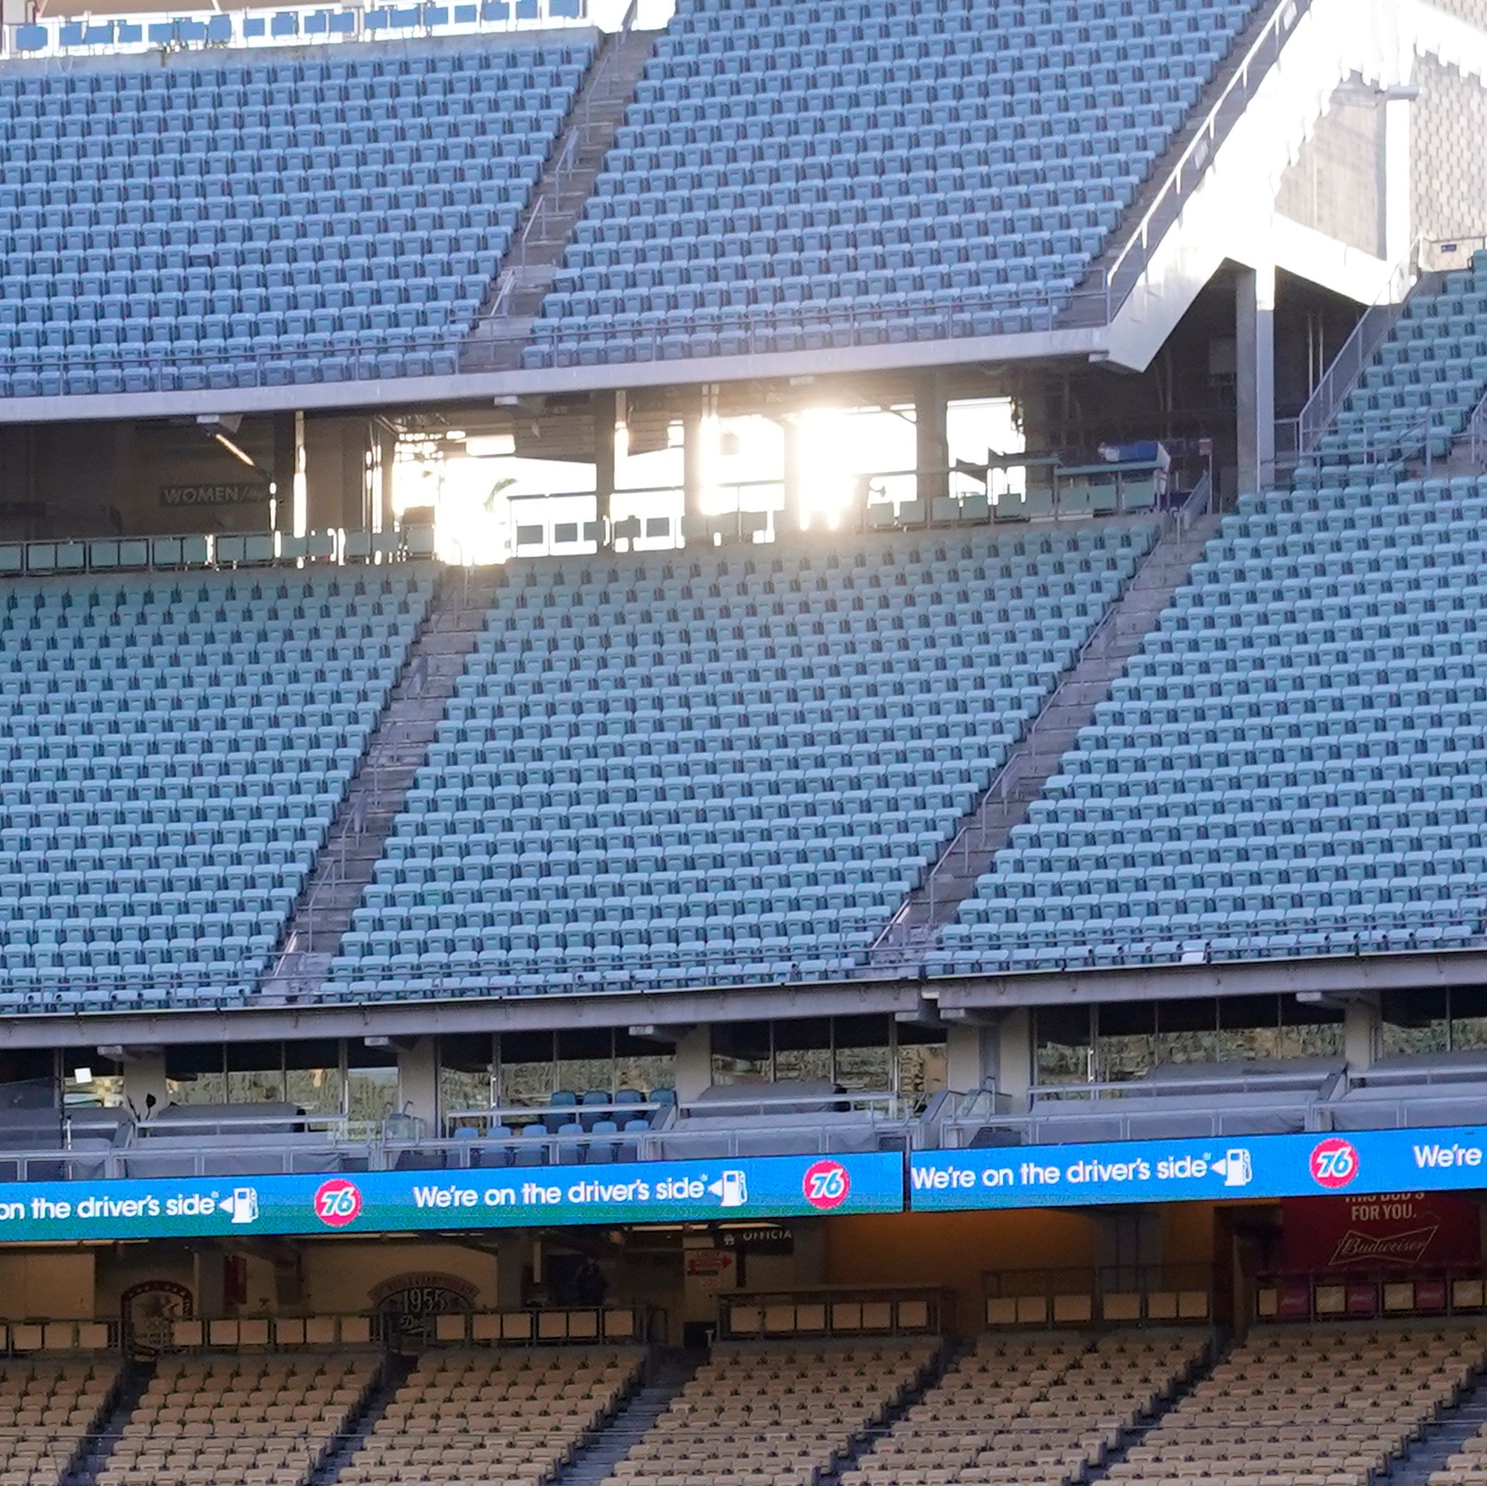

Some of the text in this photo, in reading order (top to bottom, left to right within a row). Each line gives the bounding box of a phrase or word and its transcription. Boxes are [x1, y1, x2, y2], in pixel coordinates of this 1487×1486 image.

[1316, 1145, 1354, 1179] 76
[1413, 1144, 1482, 1168] We're
[808, 1169, 845, 1199] 76
[911, 1166, 976, 1189] We're
[982, 1168, 1013, 1187] on
[1020, 1163, 1060, 1184] the
[1066, 1159, 1150, 1183] driver's
[31, 1198, 71, 1219] the
[77, 1195, 160, 1218] driver's
[320, 1187, 357, 1218] 76
[413, 1186, 478, 1208] We're
[484, 1188, 515, 1206] on
[522, 1183, 562, 1204] the
[567, 1180, 649, 1203] driver's
[1351, 1203, 1417, 1221] FOR YOU.
[1339, 1238, 1427, 1257] Budweiser
[402, 1288, 447, 1312] 1955
